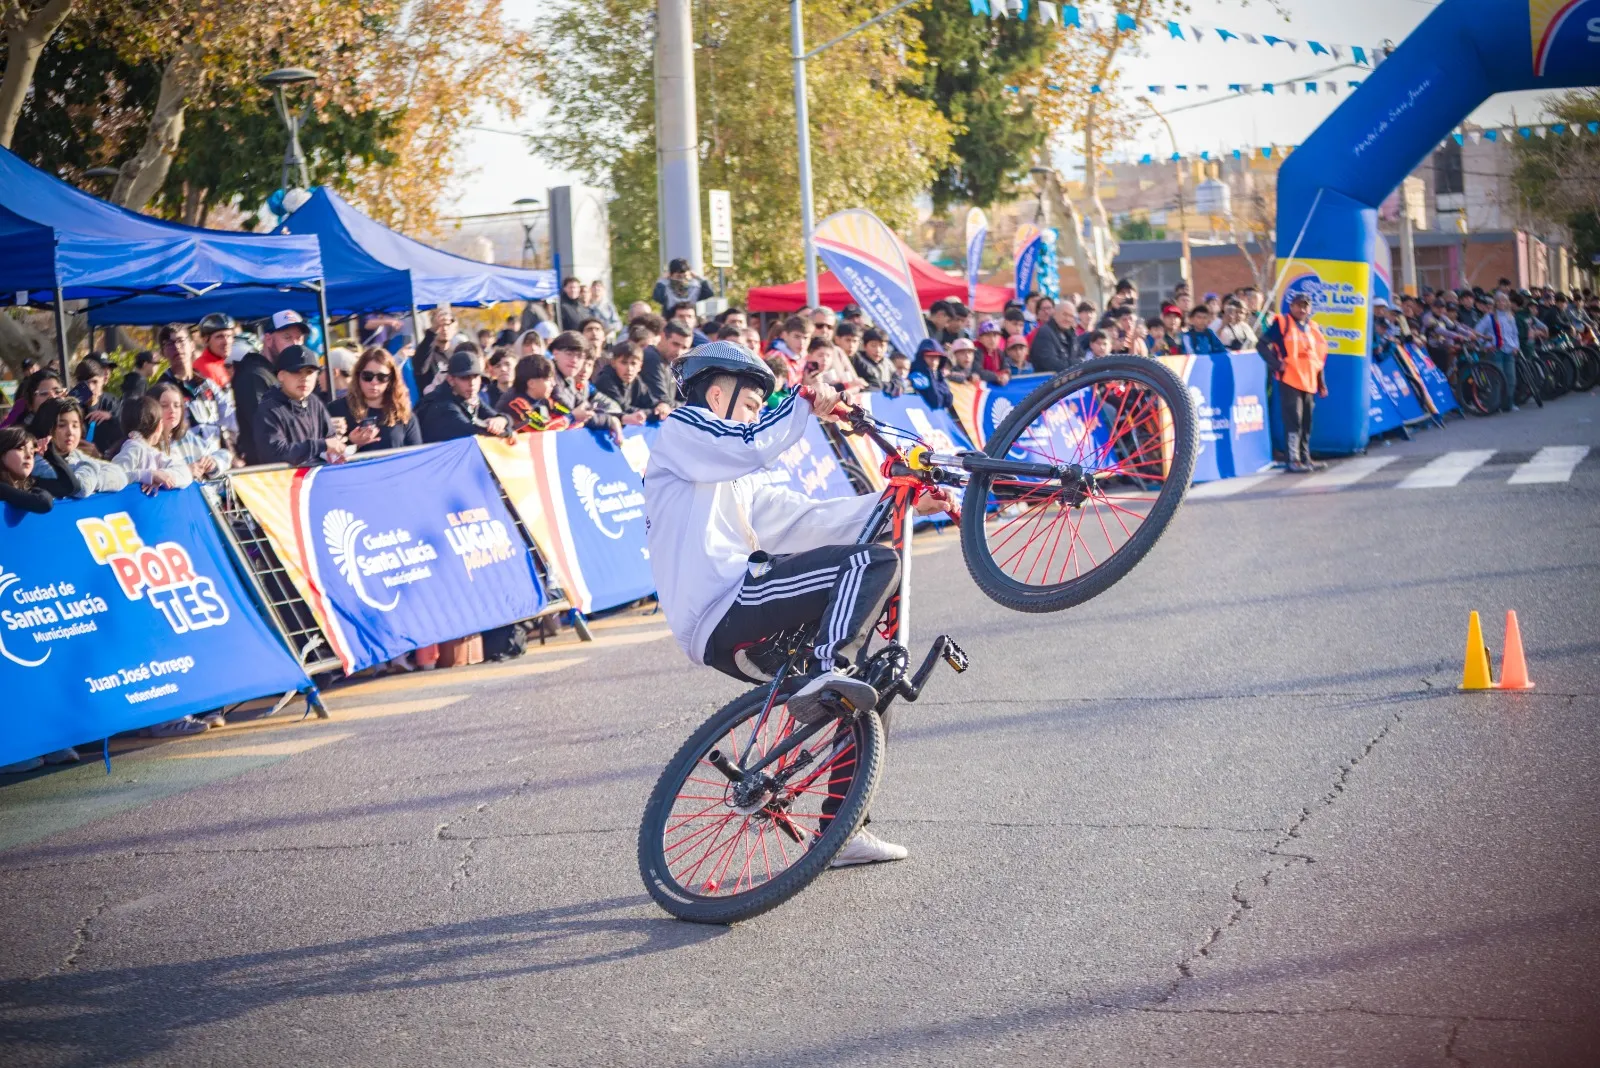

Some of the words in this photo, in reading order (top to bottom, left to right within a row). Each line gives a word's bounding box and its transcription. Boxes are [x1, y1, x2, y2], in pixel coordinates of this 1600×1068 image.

[362, 530, 398, 550] Ciudad
[396, 528, 412, 543] de
[444, 520, 513, 555] LUGAR
[356, 551, 401, 576] Santa
[396, 540, 438, 566] Lucía
[13, 586, 58, 604] Ciudad
[58, 581, 76, 596] de
[147, 576, 230, 634] TES
[1, 606, 58, 630] Santa
[55, 592, 108, 620] Lucía
[32, 620, 98, 643] Municipalidad
[85, 674, 121, 693] Juan
[118, 663, 151, 685] José
[149, 655, 195, 673] Orrego
[125, 683, 179, 704] Intendente
